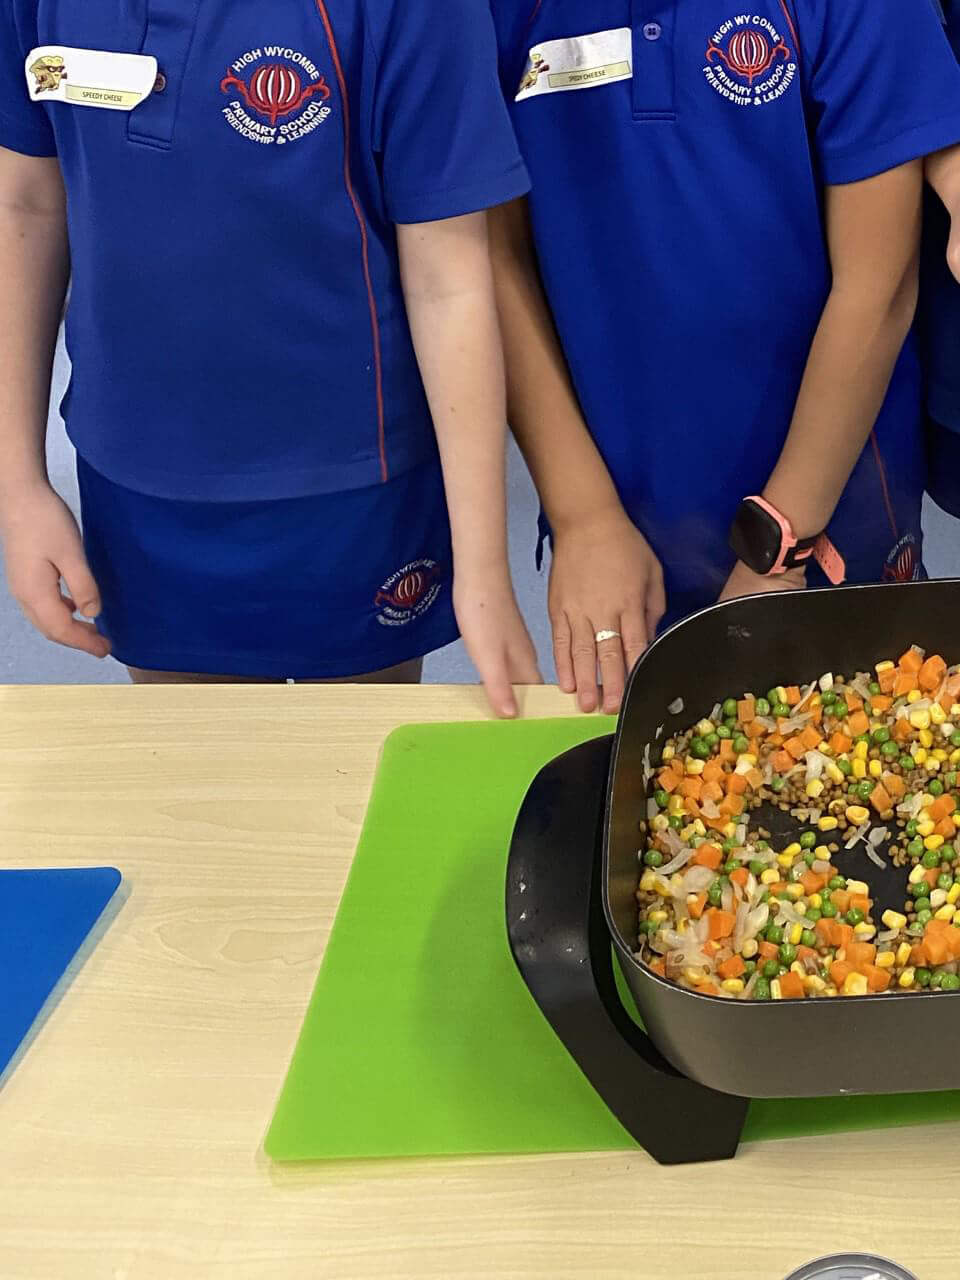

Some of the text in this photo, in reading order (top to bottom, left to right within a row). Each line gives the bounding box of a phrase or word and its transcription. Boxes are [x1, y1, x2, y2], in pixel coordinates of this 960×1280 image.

[712, 20, 733, 44] HIGH
[231, 46, 320, 81] HIGH WYCOMBE
[714, 64, 784, 96] PRIMARY SCHOOL
[703, 66, 752, 105] FRIENDSHIP
[763, 63, 796, 102] LEARNING
[222, 107, 274, 145] FRIENDSHIP
[287, 106, 331, 142] LEARNING
[229, 100, 323, 136] PRIMARY SCHOOL
